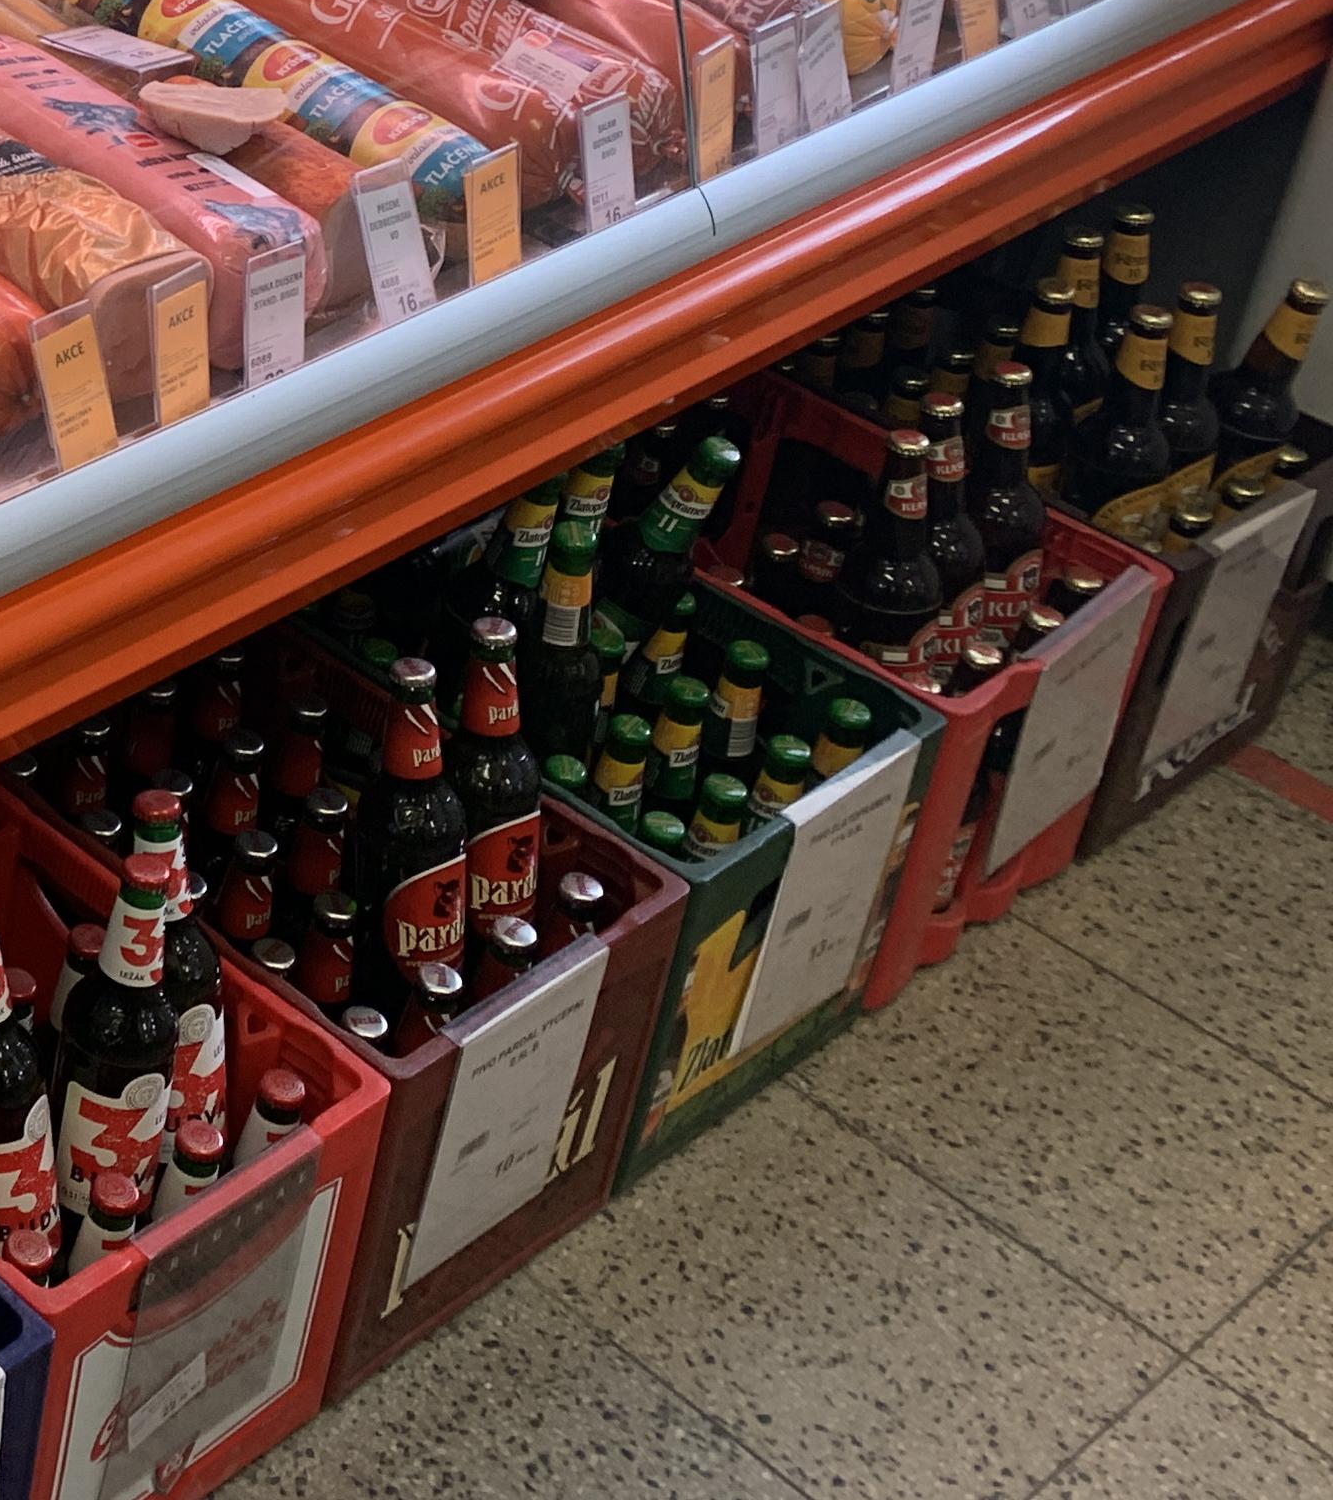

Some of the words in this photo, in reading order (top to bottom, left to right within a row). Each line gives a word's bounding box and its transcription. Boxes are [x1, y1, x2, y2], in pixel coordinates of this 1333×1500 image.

[479, 171, 507, 195] AKCE
[168, 304, 196, 330] AKCE
[54, 340, 86, 369] AKCE
